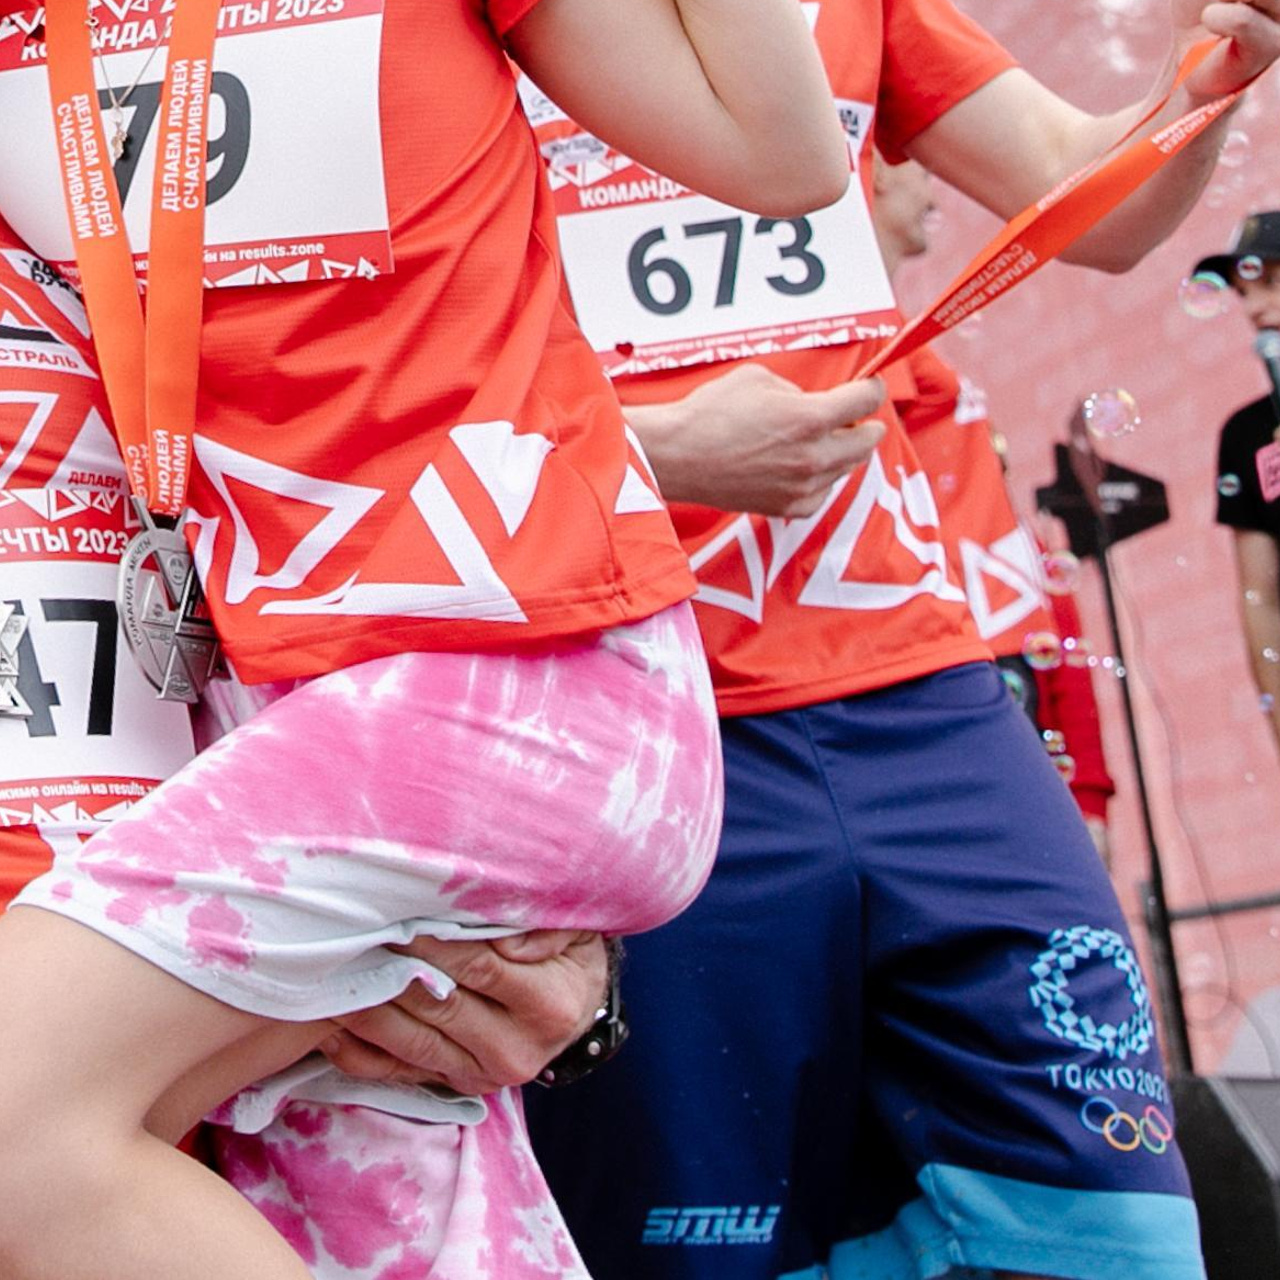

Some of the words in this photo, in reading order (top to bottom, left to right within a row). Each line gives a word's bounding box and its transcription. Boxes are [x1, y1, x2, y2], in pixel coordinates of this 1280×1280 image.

[168, 59, 190, 128] ЛЮДЕЙ
[56, 102, 94, 239] СЧАСТЛИВЫМИ
[72, 93, 100, 167] ДЕЛАЕМ
[86, 169, 118, 238] ЛЮДЕЙ
[183, 59, 208, 210] СЧАСТЛИВЫМИ
[161, 132, 183, 212] ДЕЛАЕМ
[220, 250, 236, 262] на
[239, 242, 326, 260] results.zone
[627, 216, 826, 316] 673
[68, 471, 122, 489] ДЕЛАЕМ
[152, 428, 172, 505] ЛЮДЕЙ
[72, 526, 130, 556] 2023
[43, 780, 90, 797] онлайн
[91, 781, 107, 795] на
[1045, 1063, 1135, 1091] TOKYO
